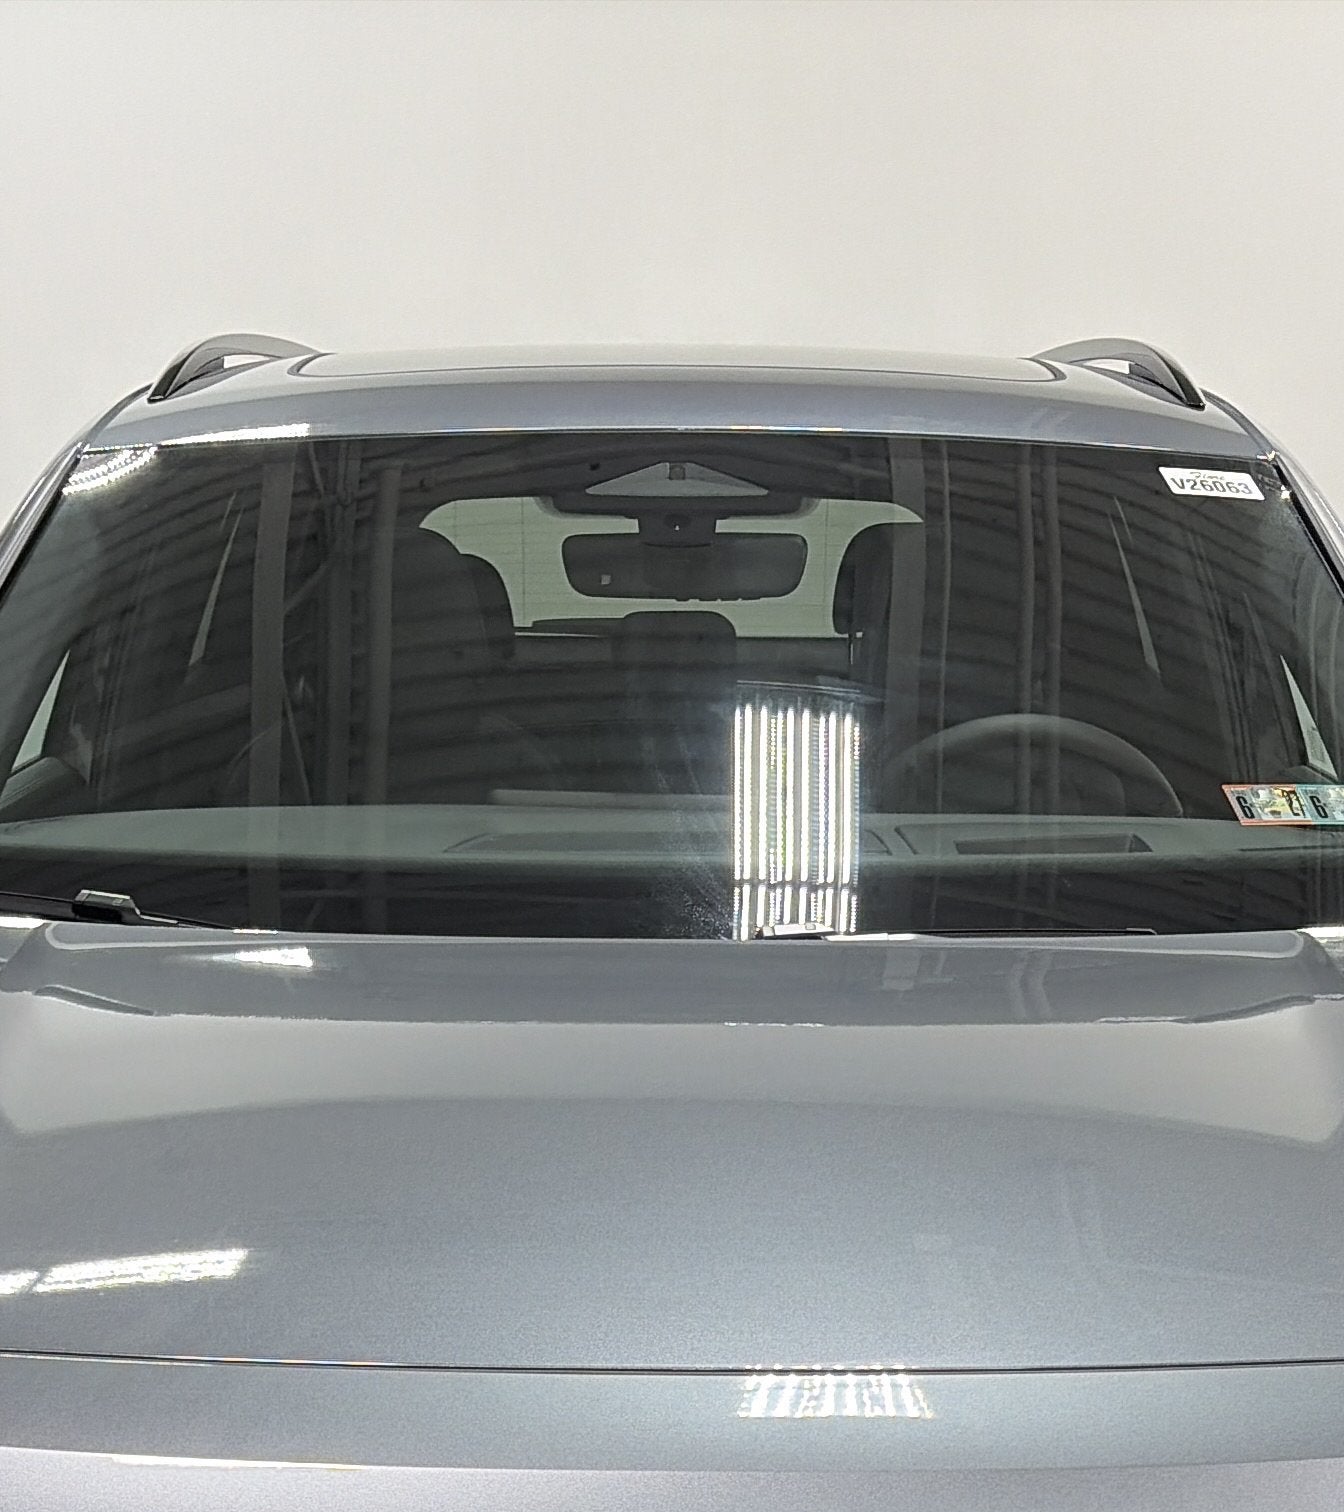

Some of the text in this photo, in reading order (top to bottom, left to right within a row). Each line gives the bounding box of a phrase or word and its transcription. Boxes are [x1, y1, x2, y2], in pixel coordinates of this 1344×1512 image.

[1170, 478, 1253, 495] V26063
[1235, 795, 1255, 819] 6
[1309, 795, 1329, 819] 6
